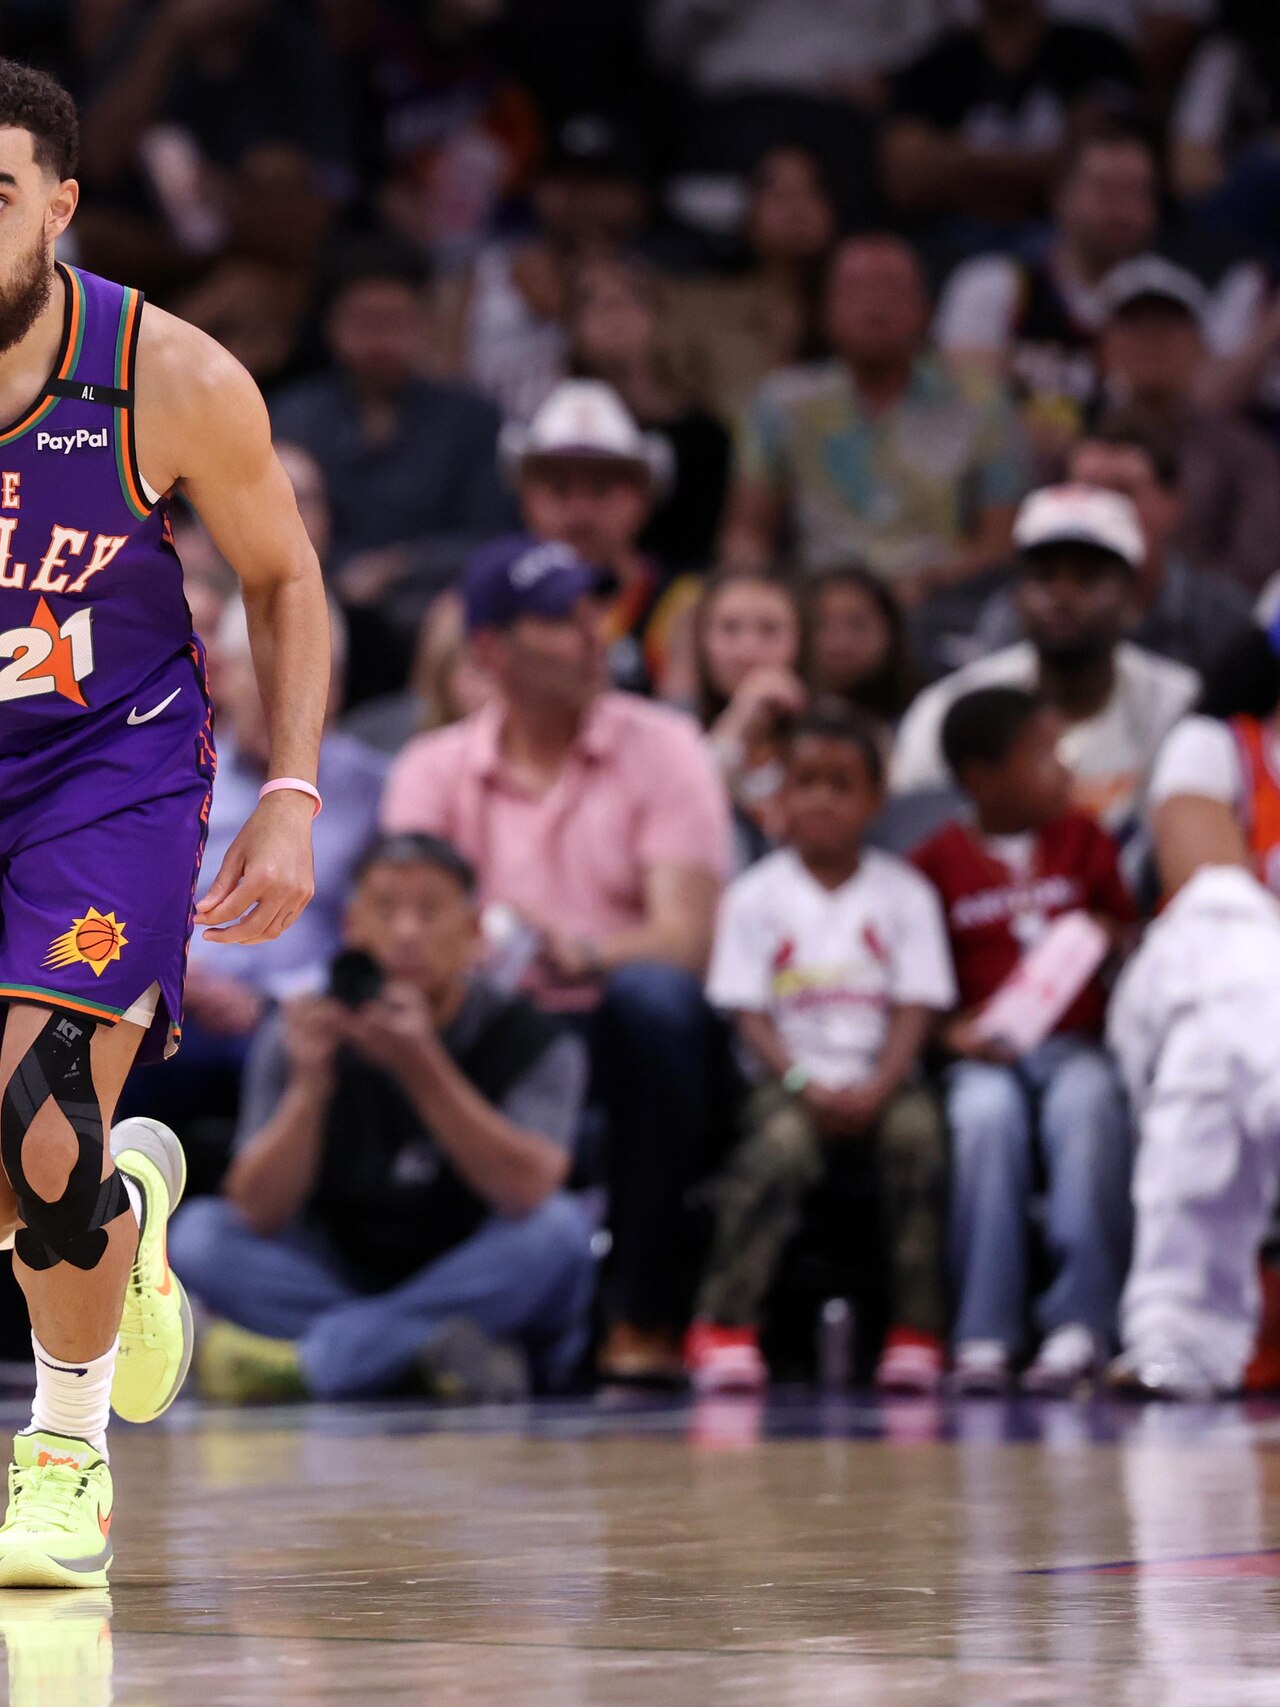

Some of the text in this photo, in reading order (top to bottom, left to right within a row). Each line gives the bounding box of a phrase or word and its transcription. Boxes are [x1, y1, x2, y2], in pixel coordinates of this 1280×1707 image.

[81, 385, 95, 401] AL
[37, 428, 108, 455] PayPal
[56, 1017, 83, 1041] KT
